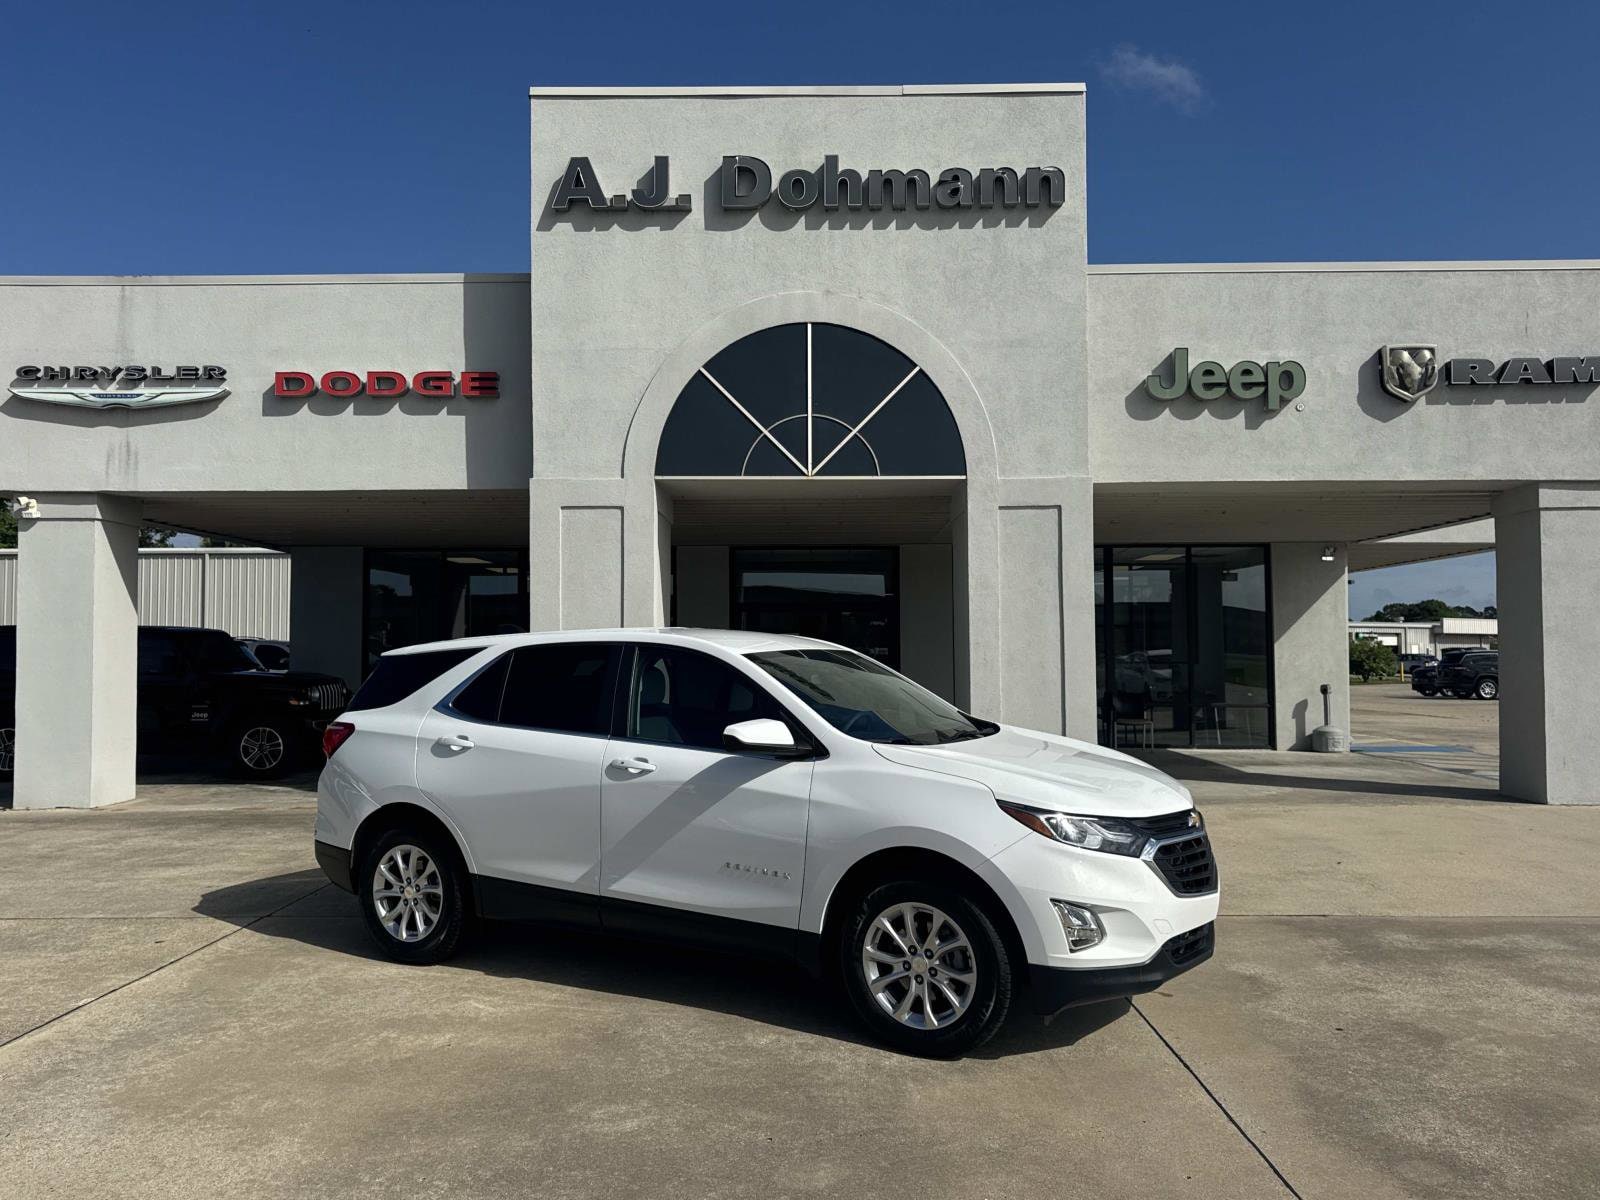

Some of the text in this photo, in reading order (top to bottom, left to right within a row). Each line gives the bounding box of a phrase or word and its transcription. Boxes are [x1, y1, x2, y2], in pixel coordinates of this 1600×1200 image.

[551, 154, 1066, 212] A.J. Dohmann
[14, 364, 228, 382] CHRYSLER
[275, 370, 500, 396] DODGE
[1146, 347, 1307, 411] Jeep
[1449, 356, 1600, 384] RAM
